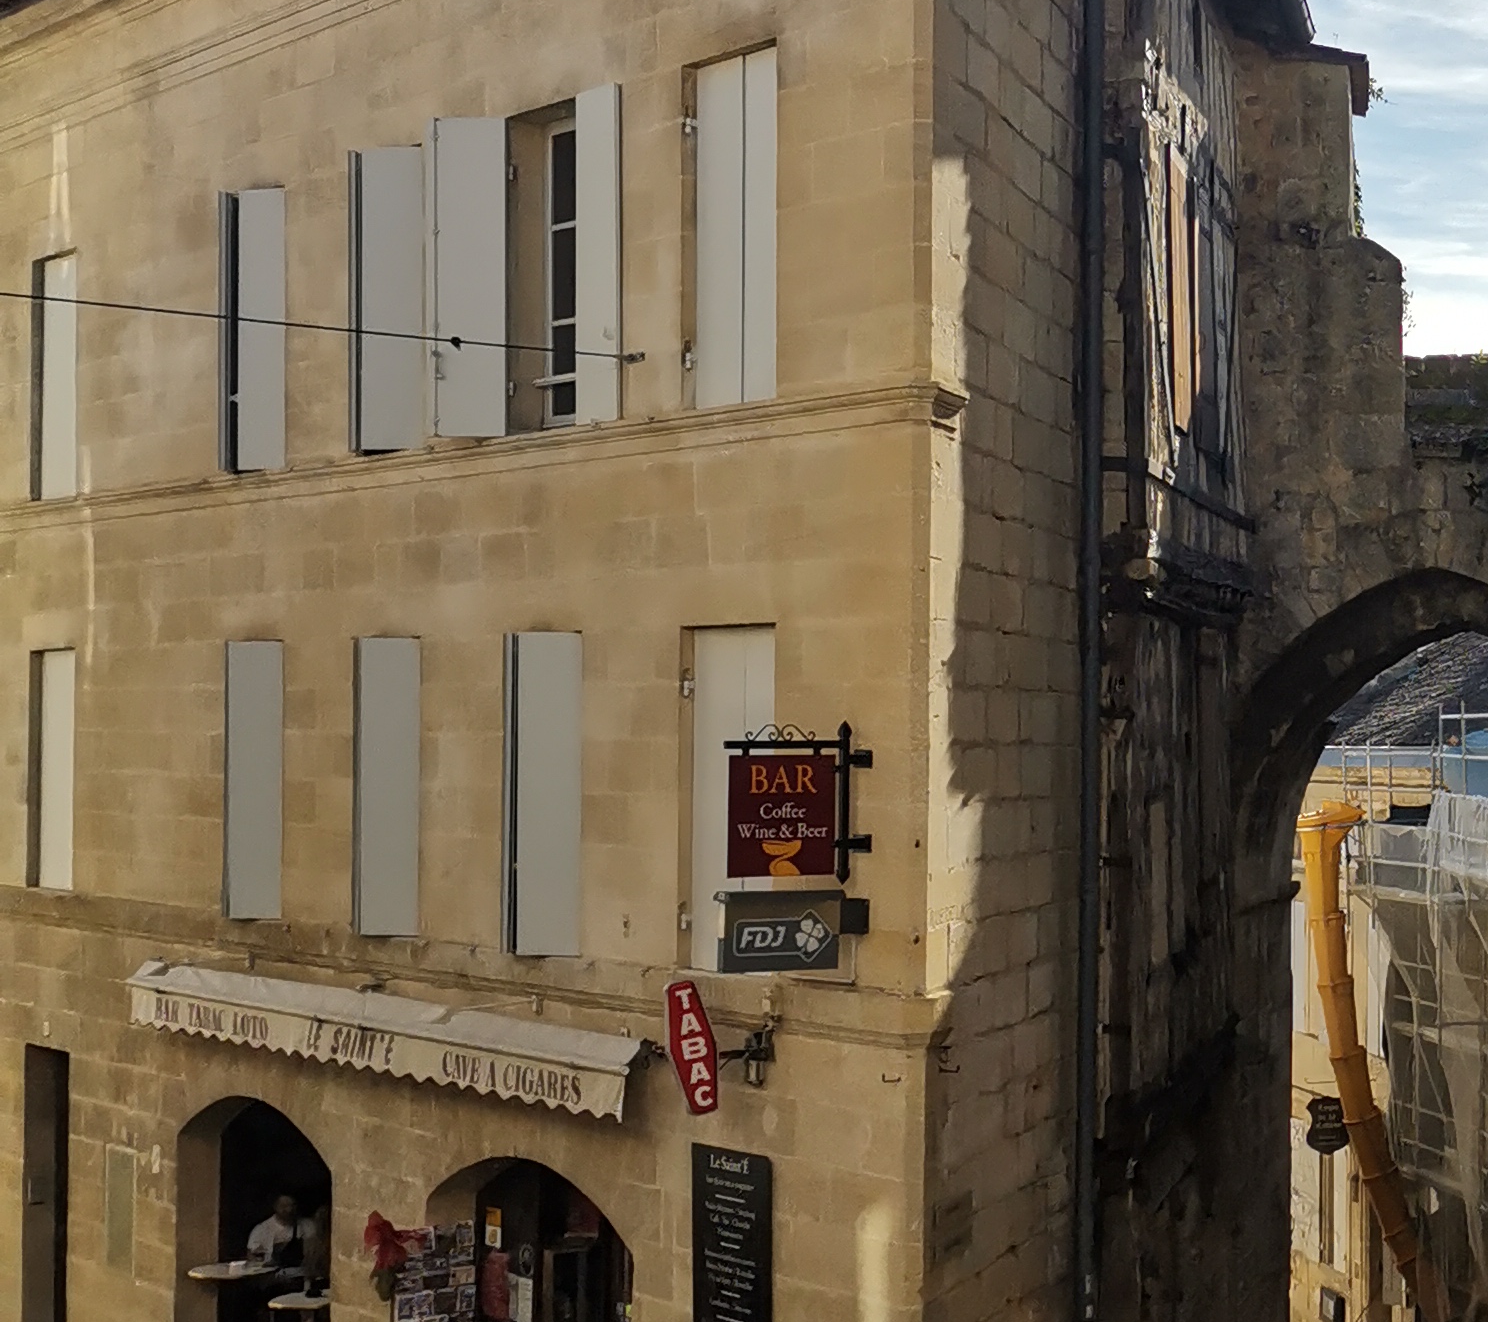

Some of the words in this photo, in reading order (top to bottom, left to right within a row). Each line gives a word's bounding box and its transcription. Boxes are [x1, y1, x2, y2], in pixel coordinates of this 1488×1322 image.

[750, 764, 818, 794] BAR
[759, 802, 807, 819] Coffee
[737, 823, 777, 839] Wine
[779, 824, 793, 839] &
[797, 823, 828, 838] Beer
[739, 926, 787, 949] FDJ
[155, 997, 180, 1023] BAR
[188, 1002, 225, 1032] TABAC
[231, 1011, 269, 1041] LOTO
[675, 988, 714, 1107] TABAC
[442, 1049, 481, 1084] CAVE
[503, 1062, 582, 1105] CIGARES
